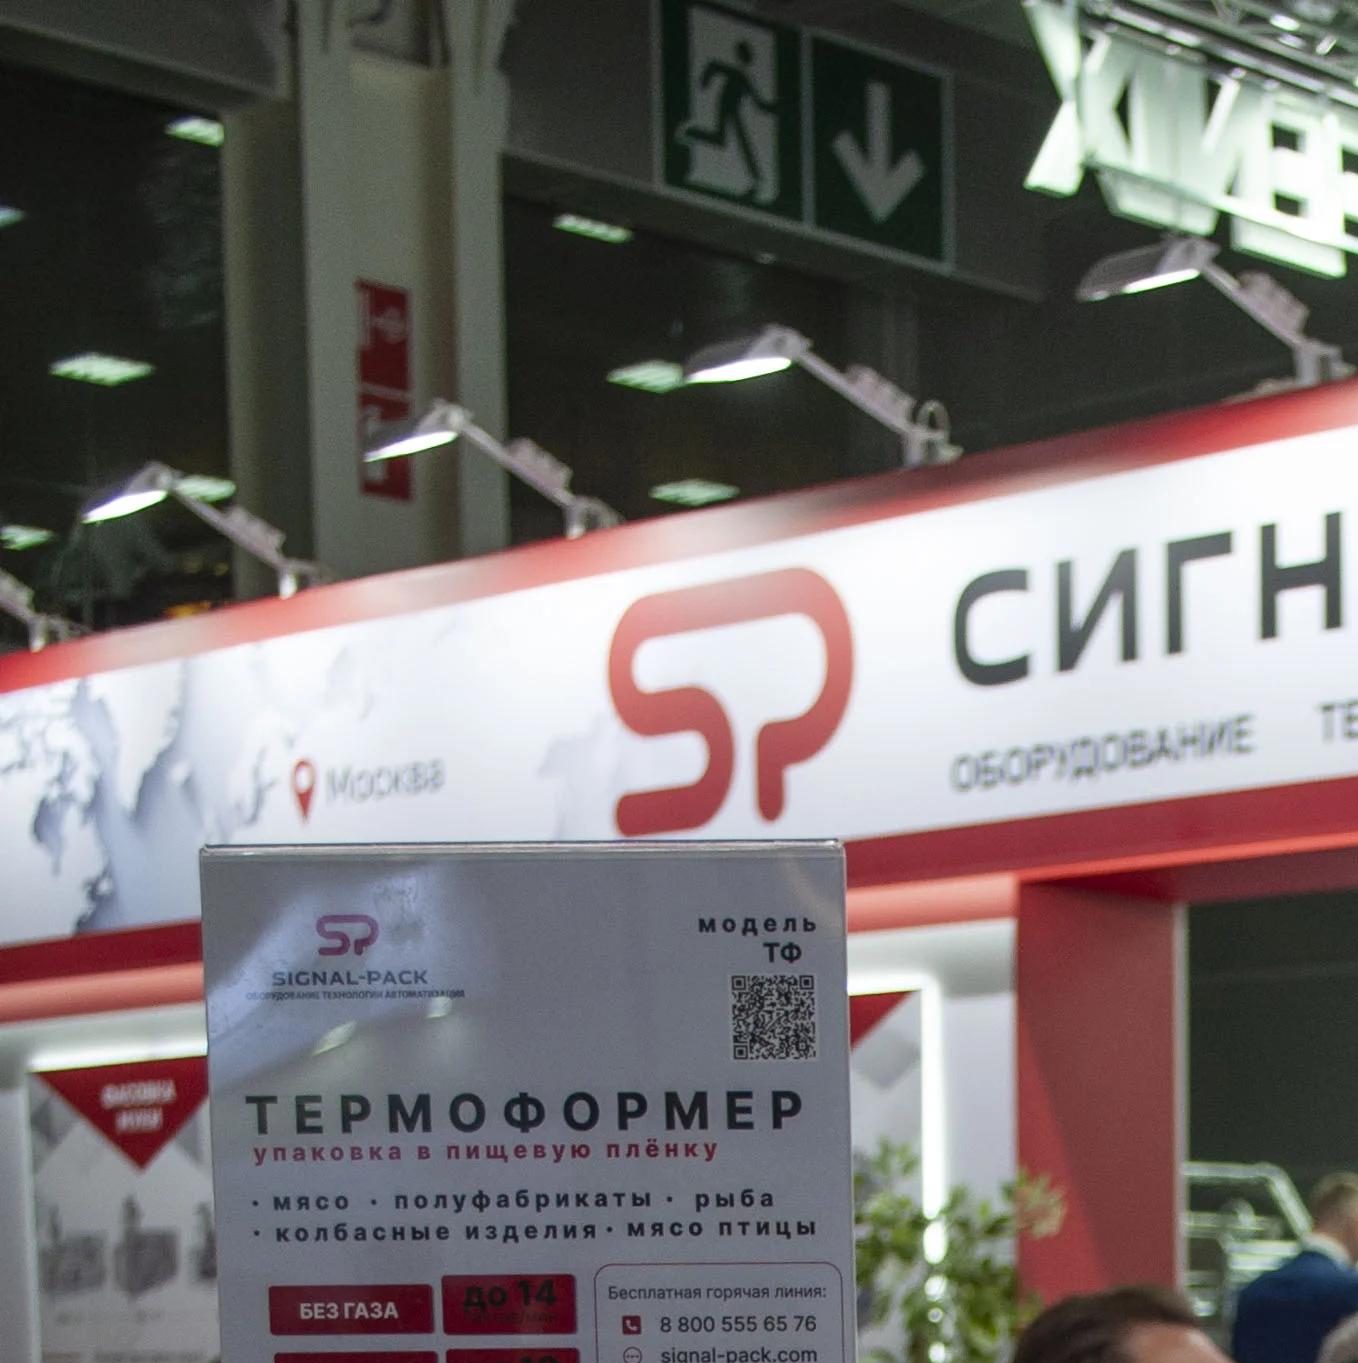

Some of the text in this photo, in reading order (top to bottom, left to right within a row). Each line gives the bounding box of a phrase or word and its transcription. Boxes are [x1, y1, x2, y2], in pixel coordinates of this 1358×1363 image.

[950, 713, 1257, 793] ОБОРУДОВАНИЕ
[699, 917, 816, 936] модель
[763, 942, 802, 964] ТФ
[272, 970, 428, 986] SIGNAL-PACK
[322, 990, 383, 1000] ТЕХНОЛОГИИ
[245, 1090, 803, 1135] ТЕРМОФОРМЕР
[253, 1139, 718, 1166] упаковка в пищевую плёнку
[273, 1189, 774, 1213] мясо полуфабрикаты рыба
[276, 1220, 816, 1243] колбасные изделия мясо птицы
[464, 1279, 557, 1313] до 14
[608, 1286, 827, 1301] Бесплатная горячая линия:
[300, 1302, 399, 1320] БЕЗ ГАЗА
[660, 1316, 817, 1332] 8 800 555 65 76
